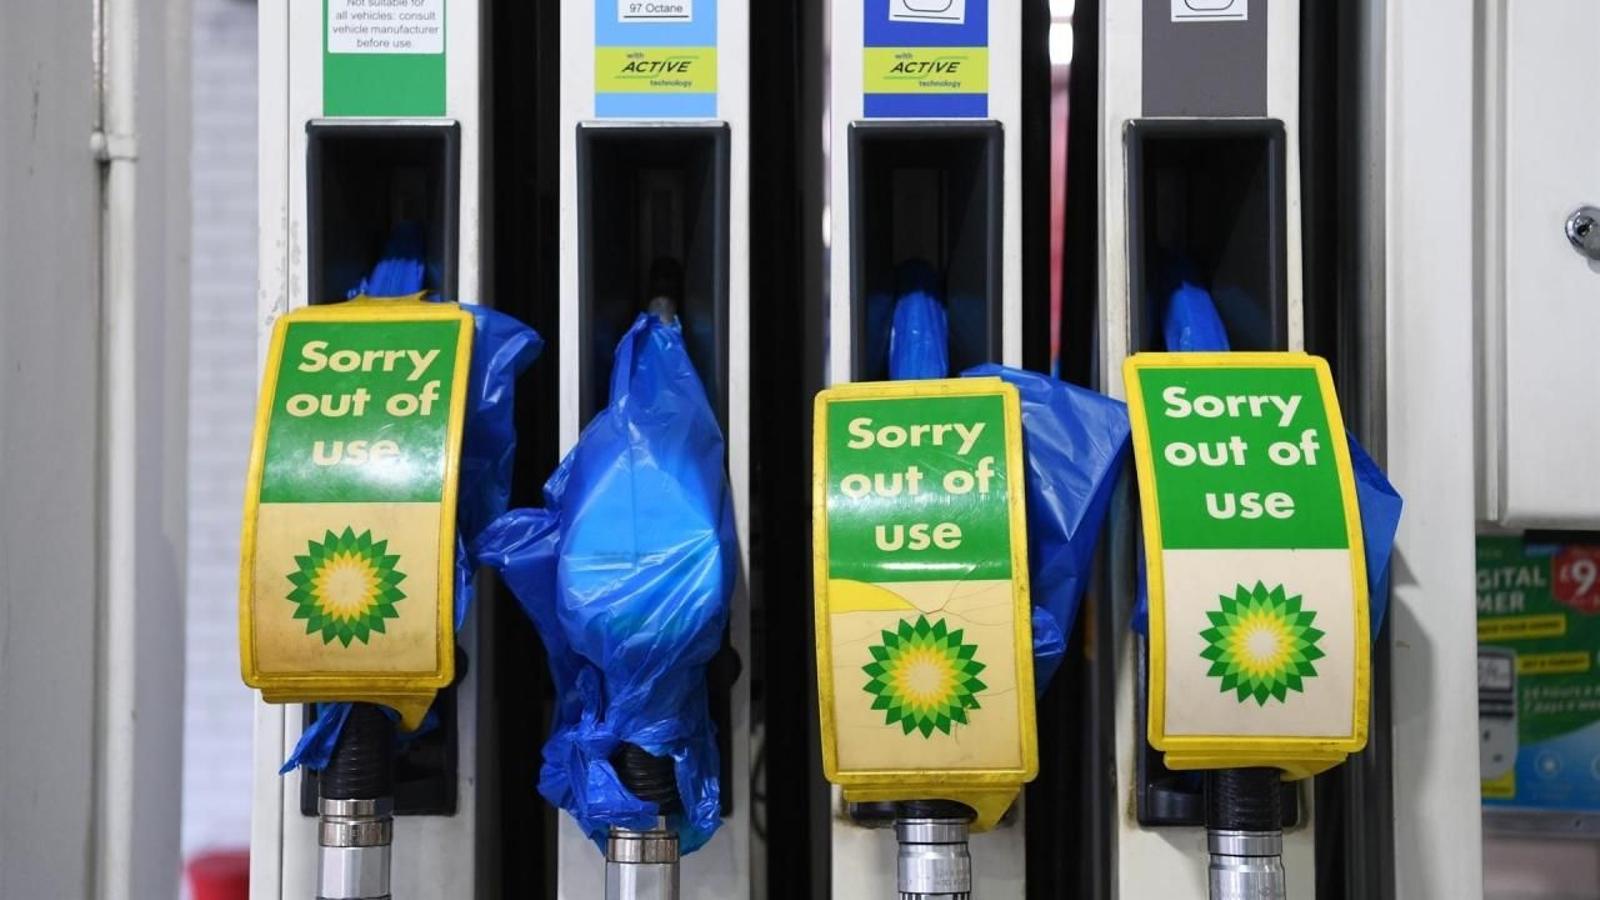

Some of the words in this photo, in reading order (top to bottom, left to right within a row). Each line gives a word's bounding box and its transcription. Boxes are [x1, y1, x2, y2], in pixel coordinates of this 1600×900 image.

[336, 11, 348, 20] all
[399, 11, 436, 20] consult
[629, 3, 642, 13] 97
[646, 3, 683, 13] Octane
[333, 24, 368, 34] vehicle
[370, 24, 439, 34] manufacturer
[356, 38, 390, 48] before
[392, 40, 412, 48] use
[626, 51, 644, 59] with
[621, 61, 692, 72] ACTIVE
[890, 61, 961, 73] ACTIVE
[650, 80, 692, 89] technology
[919, 80, 961, 89] technology
[297, 340, 441, 381] Sorry
[286, 387, 371, 418] out
[385, 380, 441, 417] of
[1162, 386, 1303, 427] Sorry
[847, 417, 987, 456] Sorry
[312, 439, 400, 466] use
[1164, 436, 1249, 467] out
[1268, 429, 1321, 466] of
[840, 465, 924, 499] out
[943, 456, 996, 495] of
[1205, 491, 1296, 519] use
[875, 521, 963, 552] use
